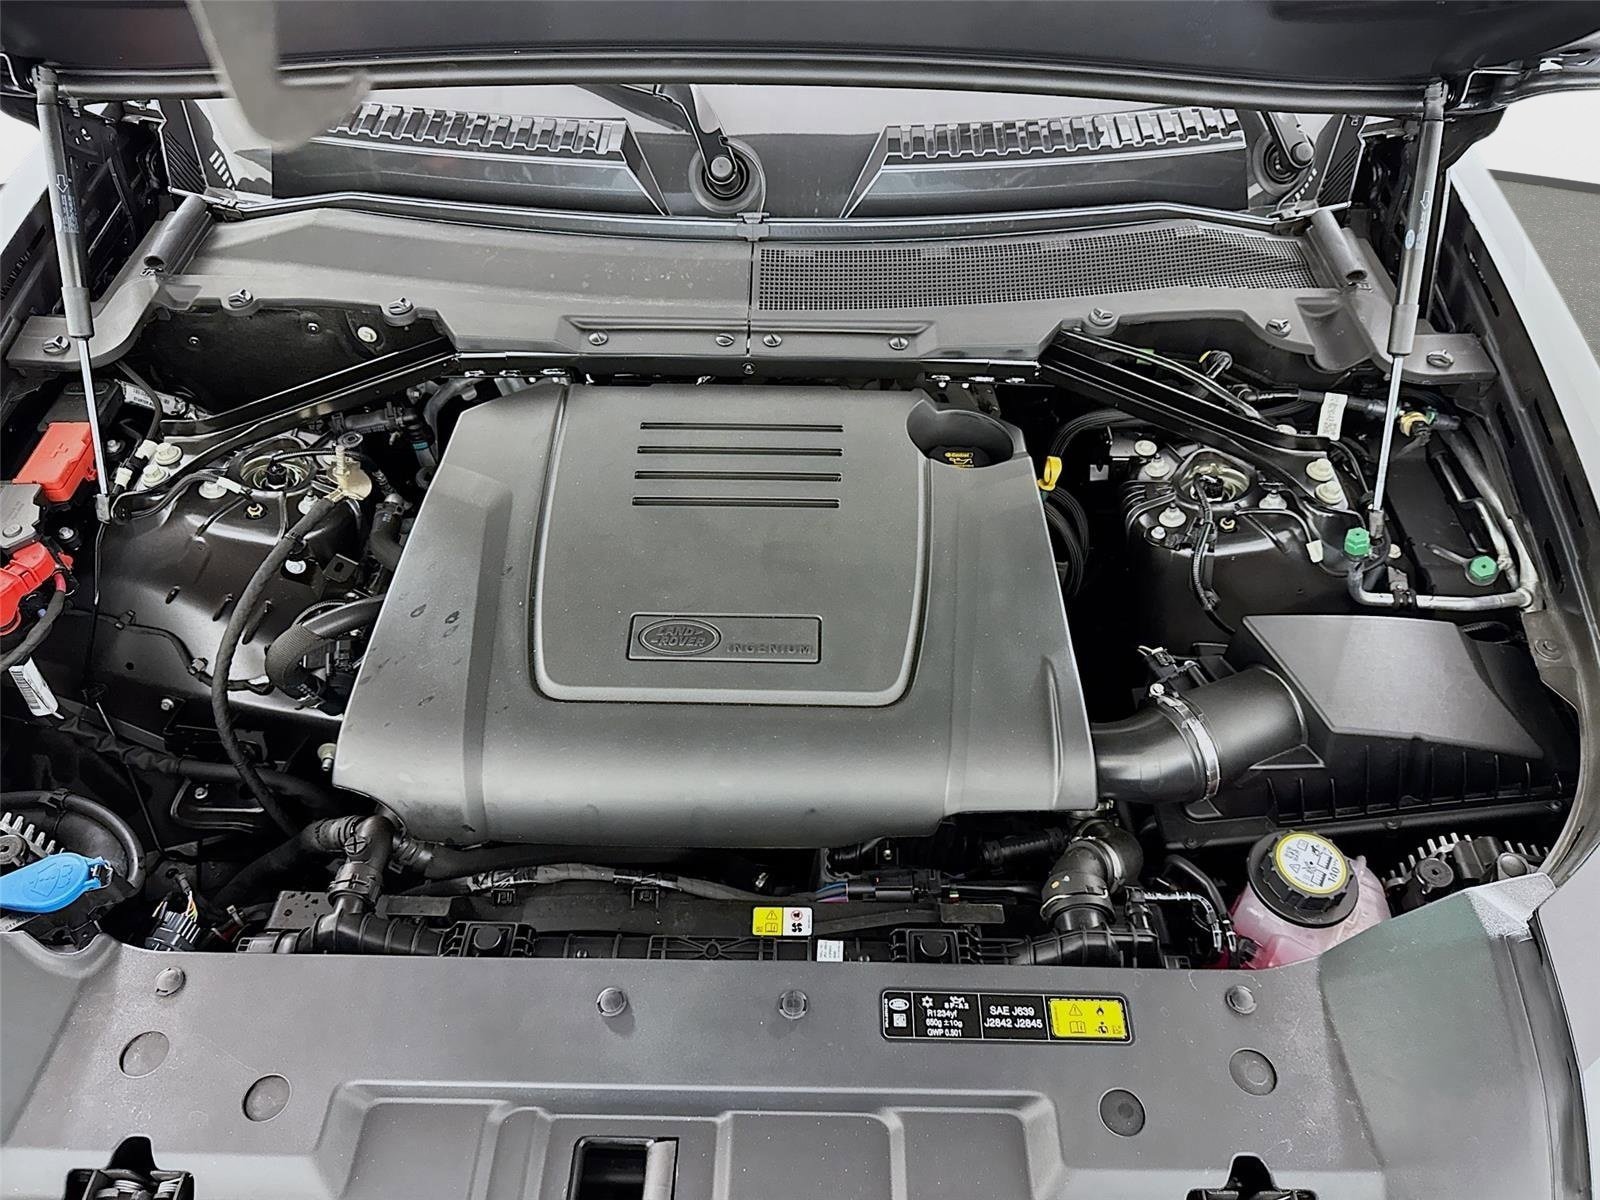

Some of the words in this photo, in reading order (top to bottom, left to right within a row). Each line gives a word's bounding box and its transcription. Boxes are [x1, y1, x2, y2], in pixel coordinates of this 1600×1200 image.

[656, 626, 694, 636] LAND
[658, 636, 706, 647] ROVER
[726, 643, 812, 655] INGENIUM
[927, 1009, 957, 1019] R1234yf
[989, 1005, 1010, 1016] SAE
[1011, 1006, 1035, 1017] J639
[984, 1017, 1013, 1028] J2842
[1014, 1018, 1043, 1029] J2845
[927, 1028, 943, 1036] GWP
